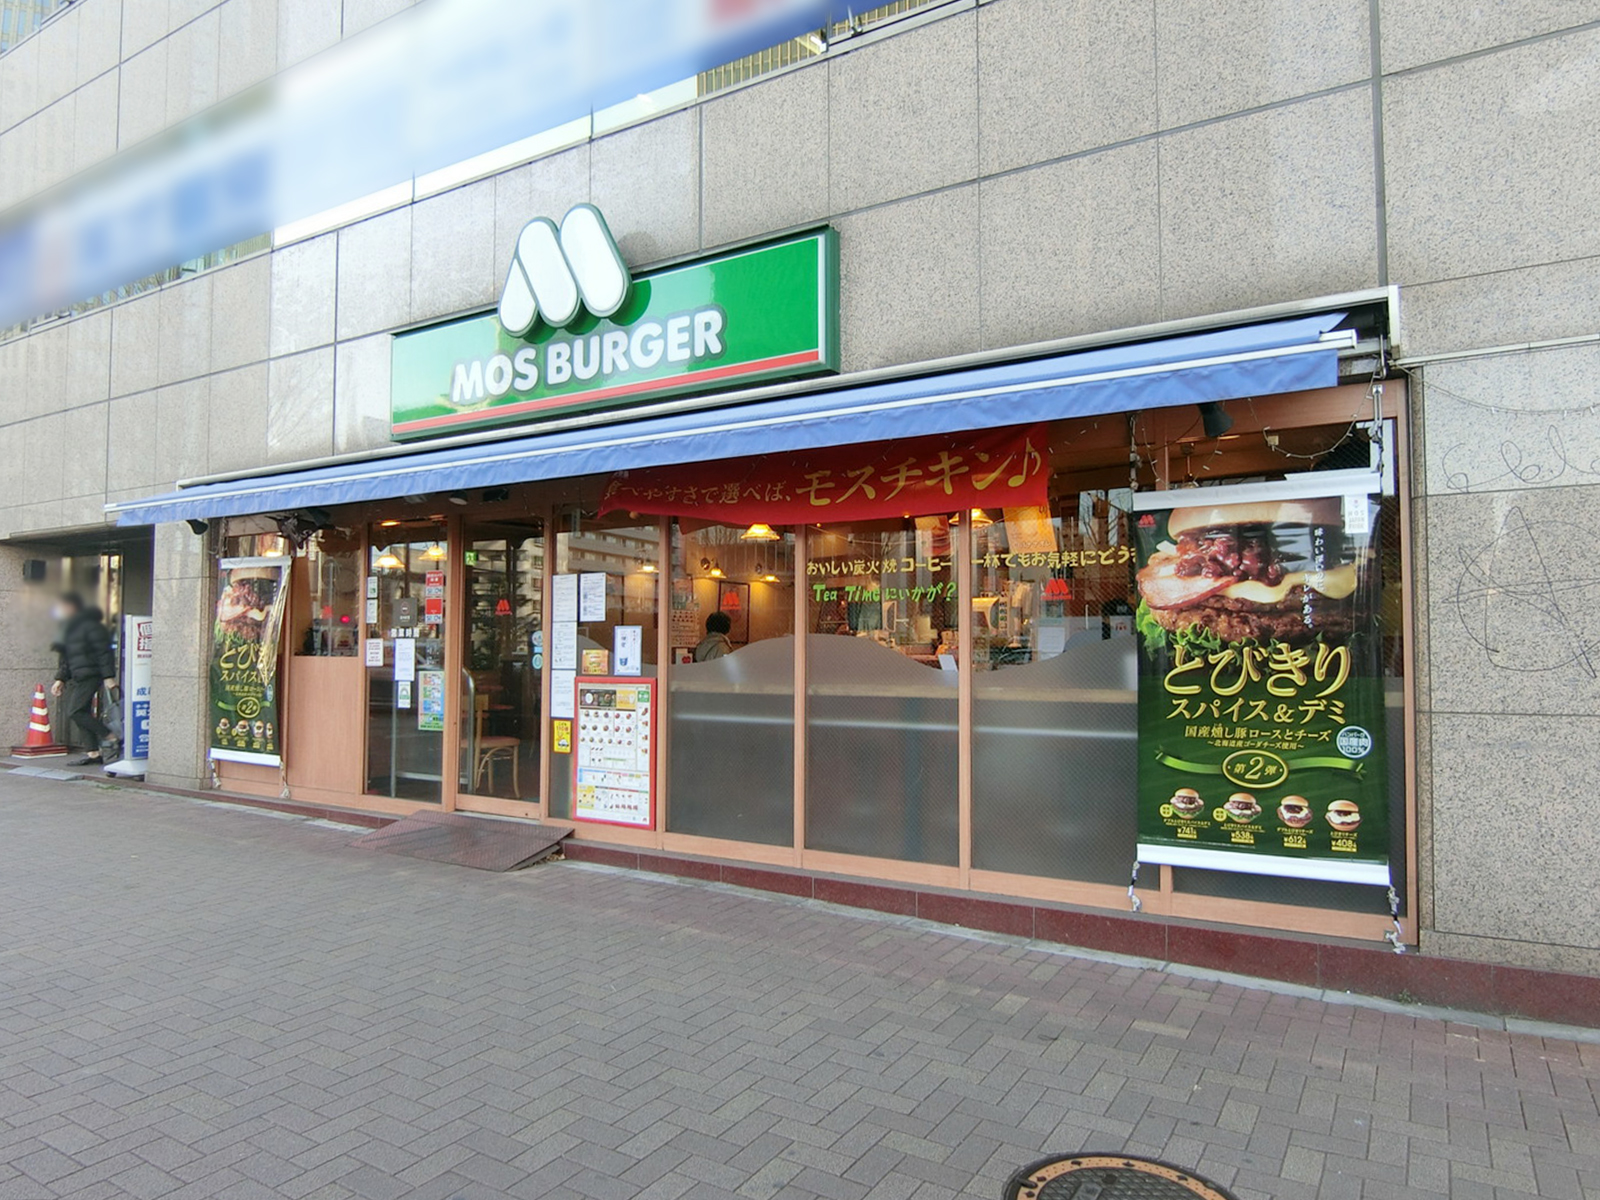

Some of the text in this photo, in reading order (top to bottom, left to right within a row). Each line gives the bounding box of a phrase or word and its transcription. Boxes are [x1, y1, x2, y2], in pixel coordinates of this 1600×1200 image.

[451, 309, 724, 402] MOS BURGER
[812, 583, 838, 602] Tea
[844, 584, 881, 602] Time
[1162, 641, 1351, 698] とびきり
